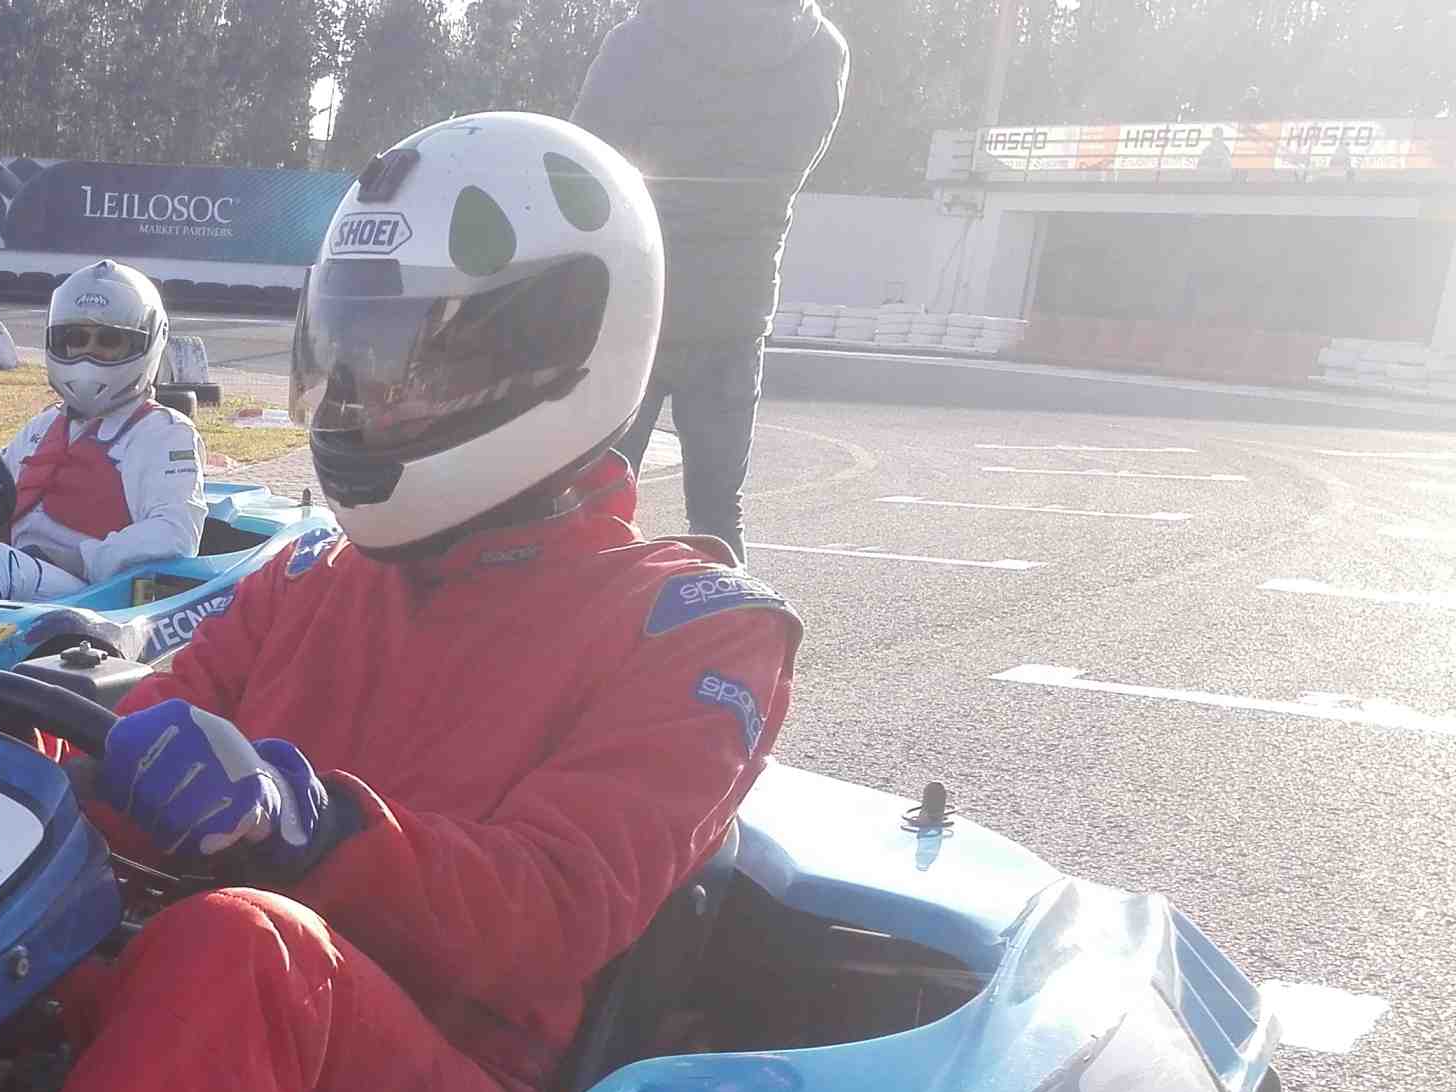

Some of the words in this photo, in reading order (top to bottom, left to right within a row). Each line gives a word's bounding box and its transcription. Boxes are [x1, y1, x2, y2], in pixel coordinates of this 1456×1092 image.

[1124, 128, 1202, 149] HASCO
[1287, 125, 1374, 147] HASCO
[80, 185, 233, 223] LEILOSOC
[138, 224, 181, 235] MARKET
[183, 226, 233, 238] PARTNERS
[333, 219, 400, 247] SHOEI
